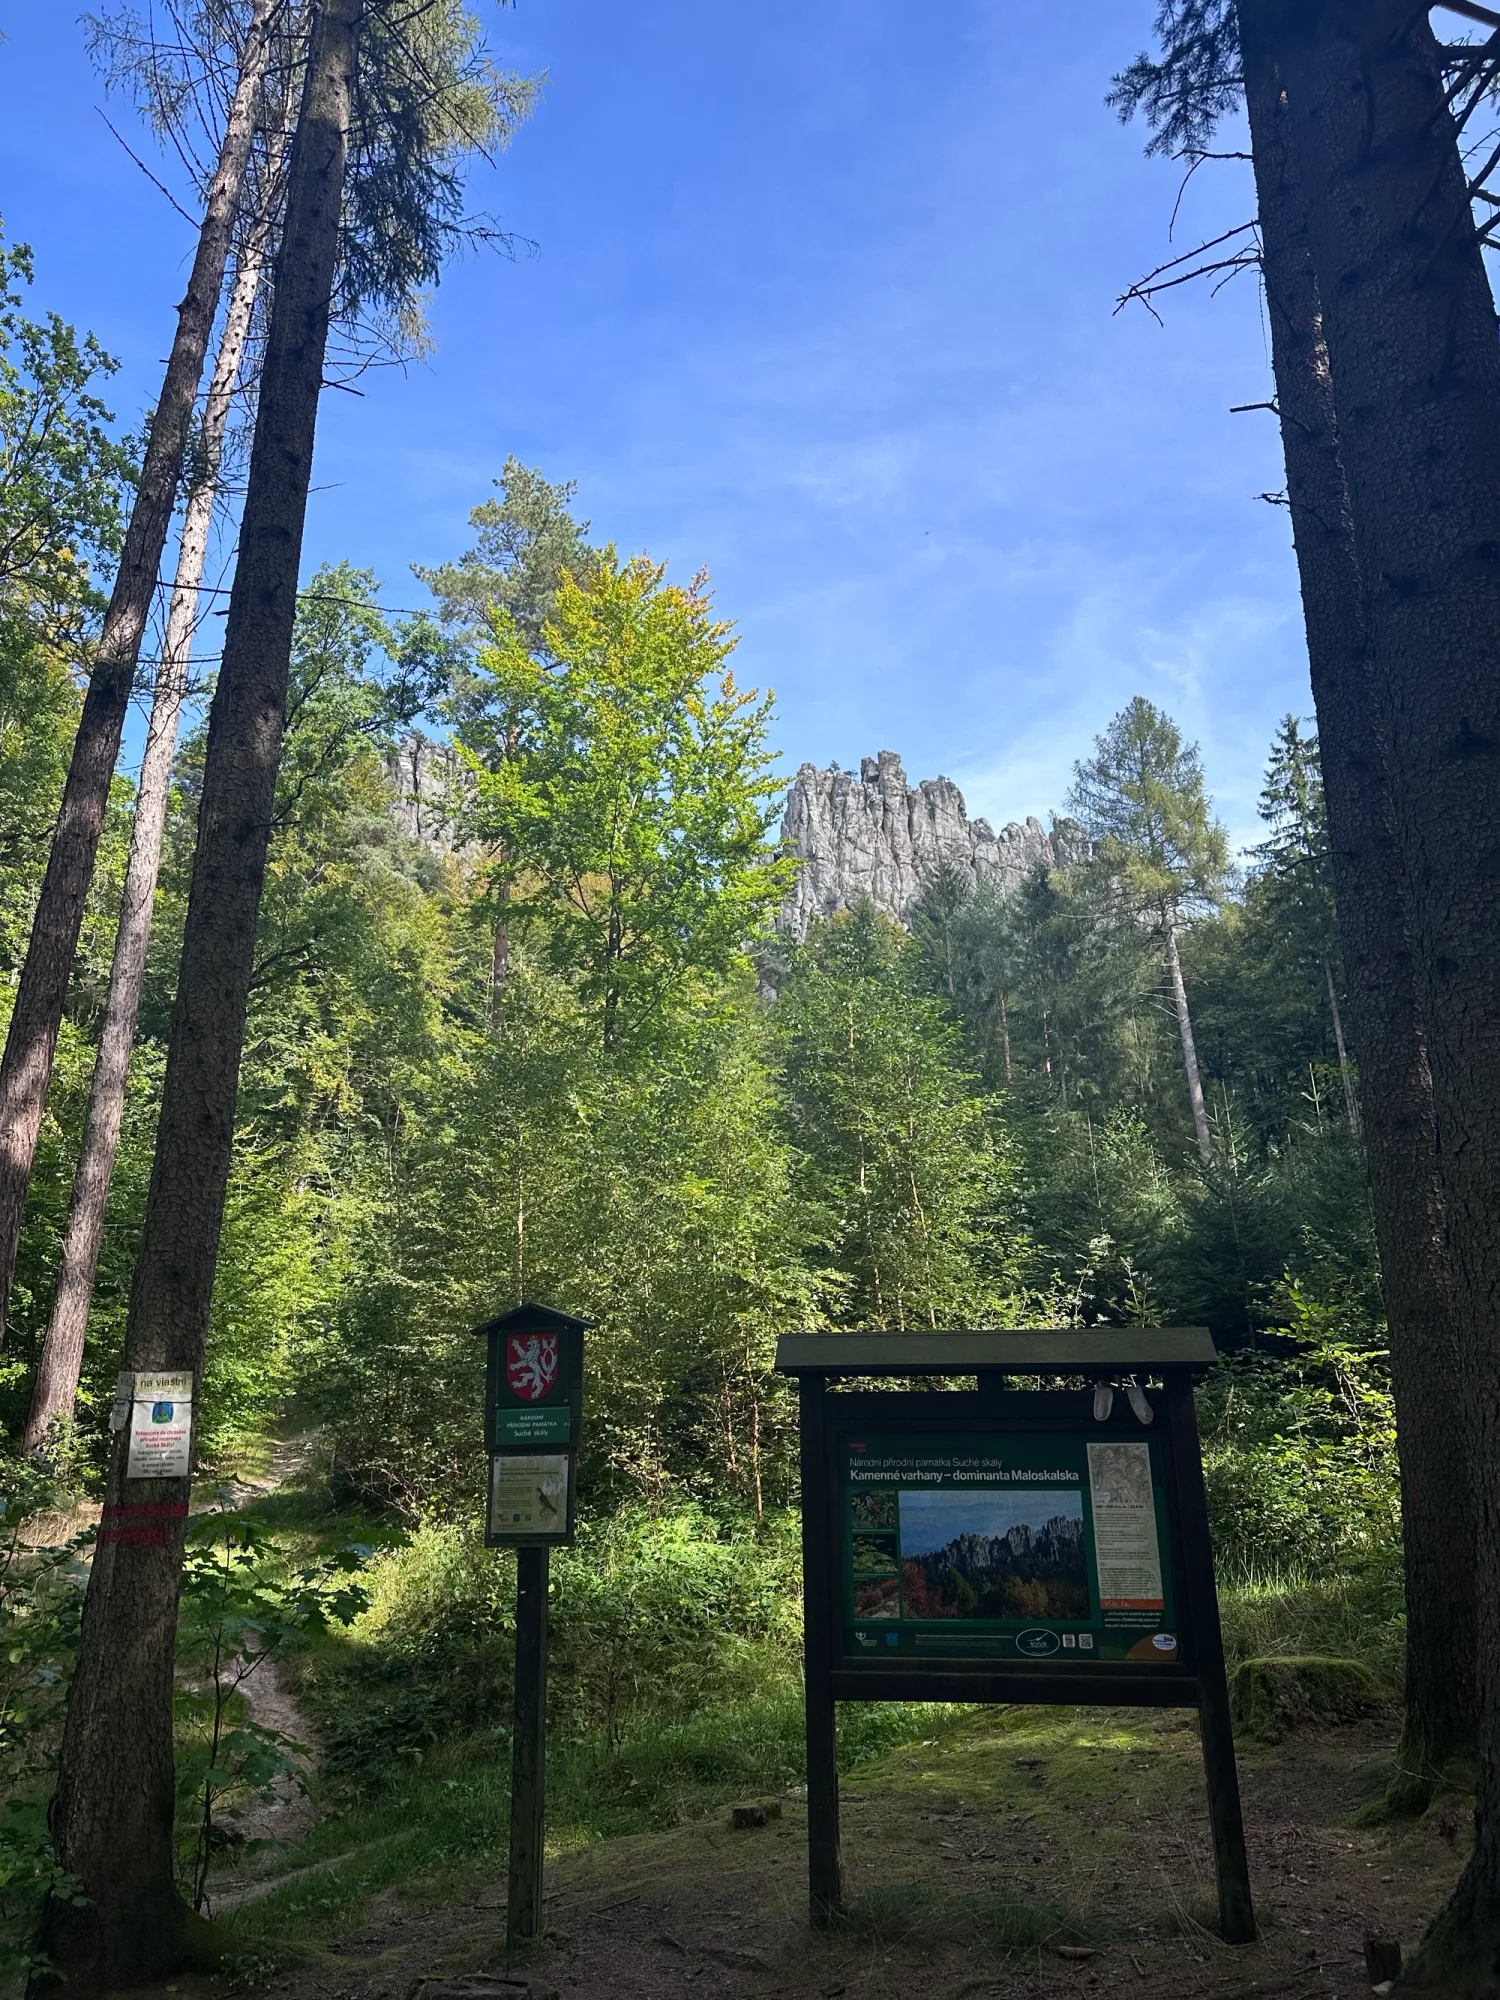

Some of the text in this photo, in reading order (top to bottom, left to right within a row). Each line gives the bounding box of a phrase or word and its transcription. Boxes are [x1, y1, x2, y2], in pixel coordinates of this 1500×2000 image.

[850, 1458, 1003, 1468] Národní přírodní památka Suché skály
[850, 1470, 900, 1481] Kamenné
[901, 1470, 943, 1483] varhany
[953, 1470, 1010, 1481] dominanta
[1012, 1470, 1079, 1481] Maloskalska
